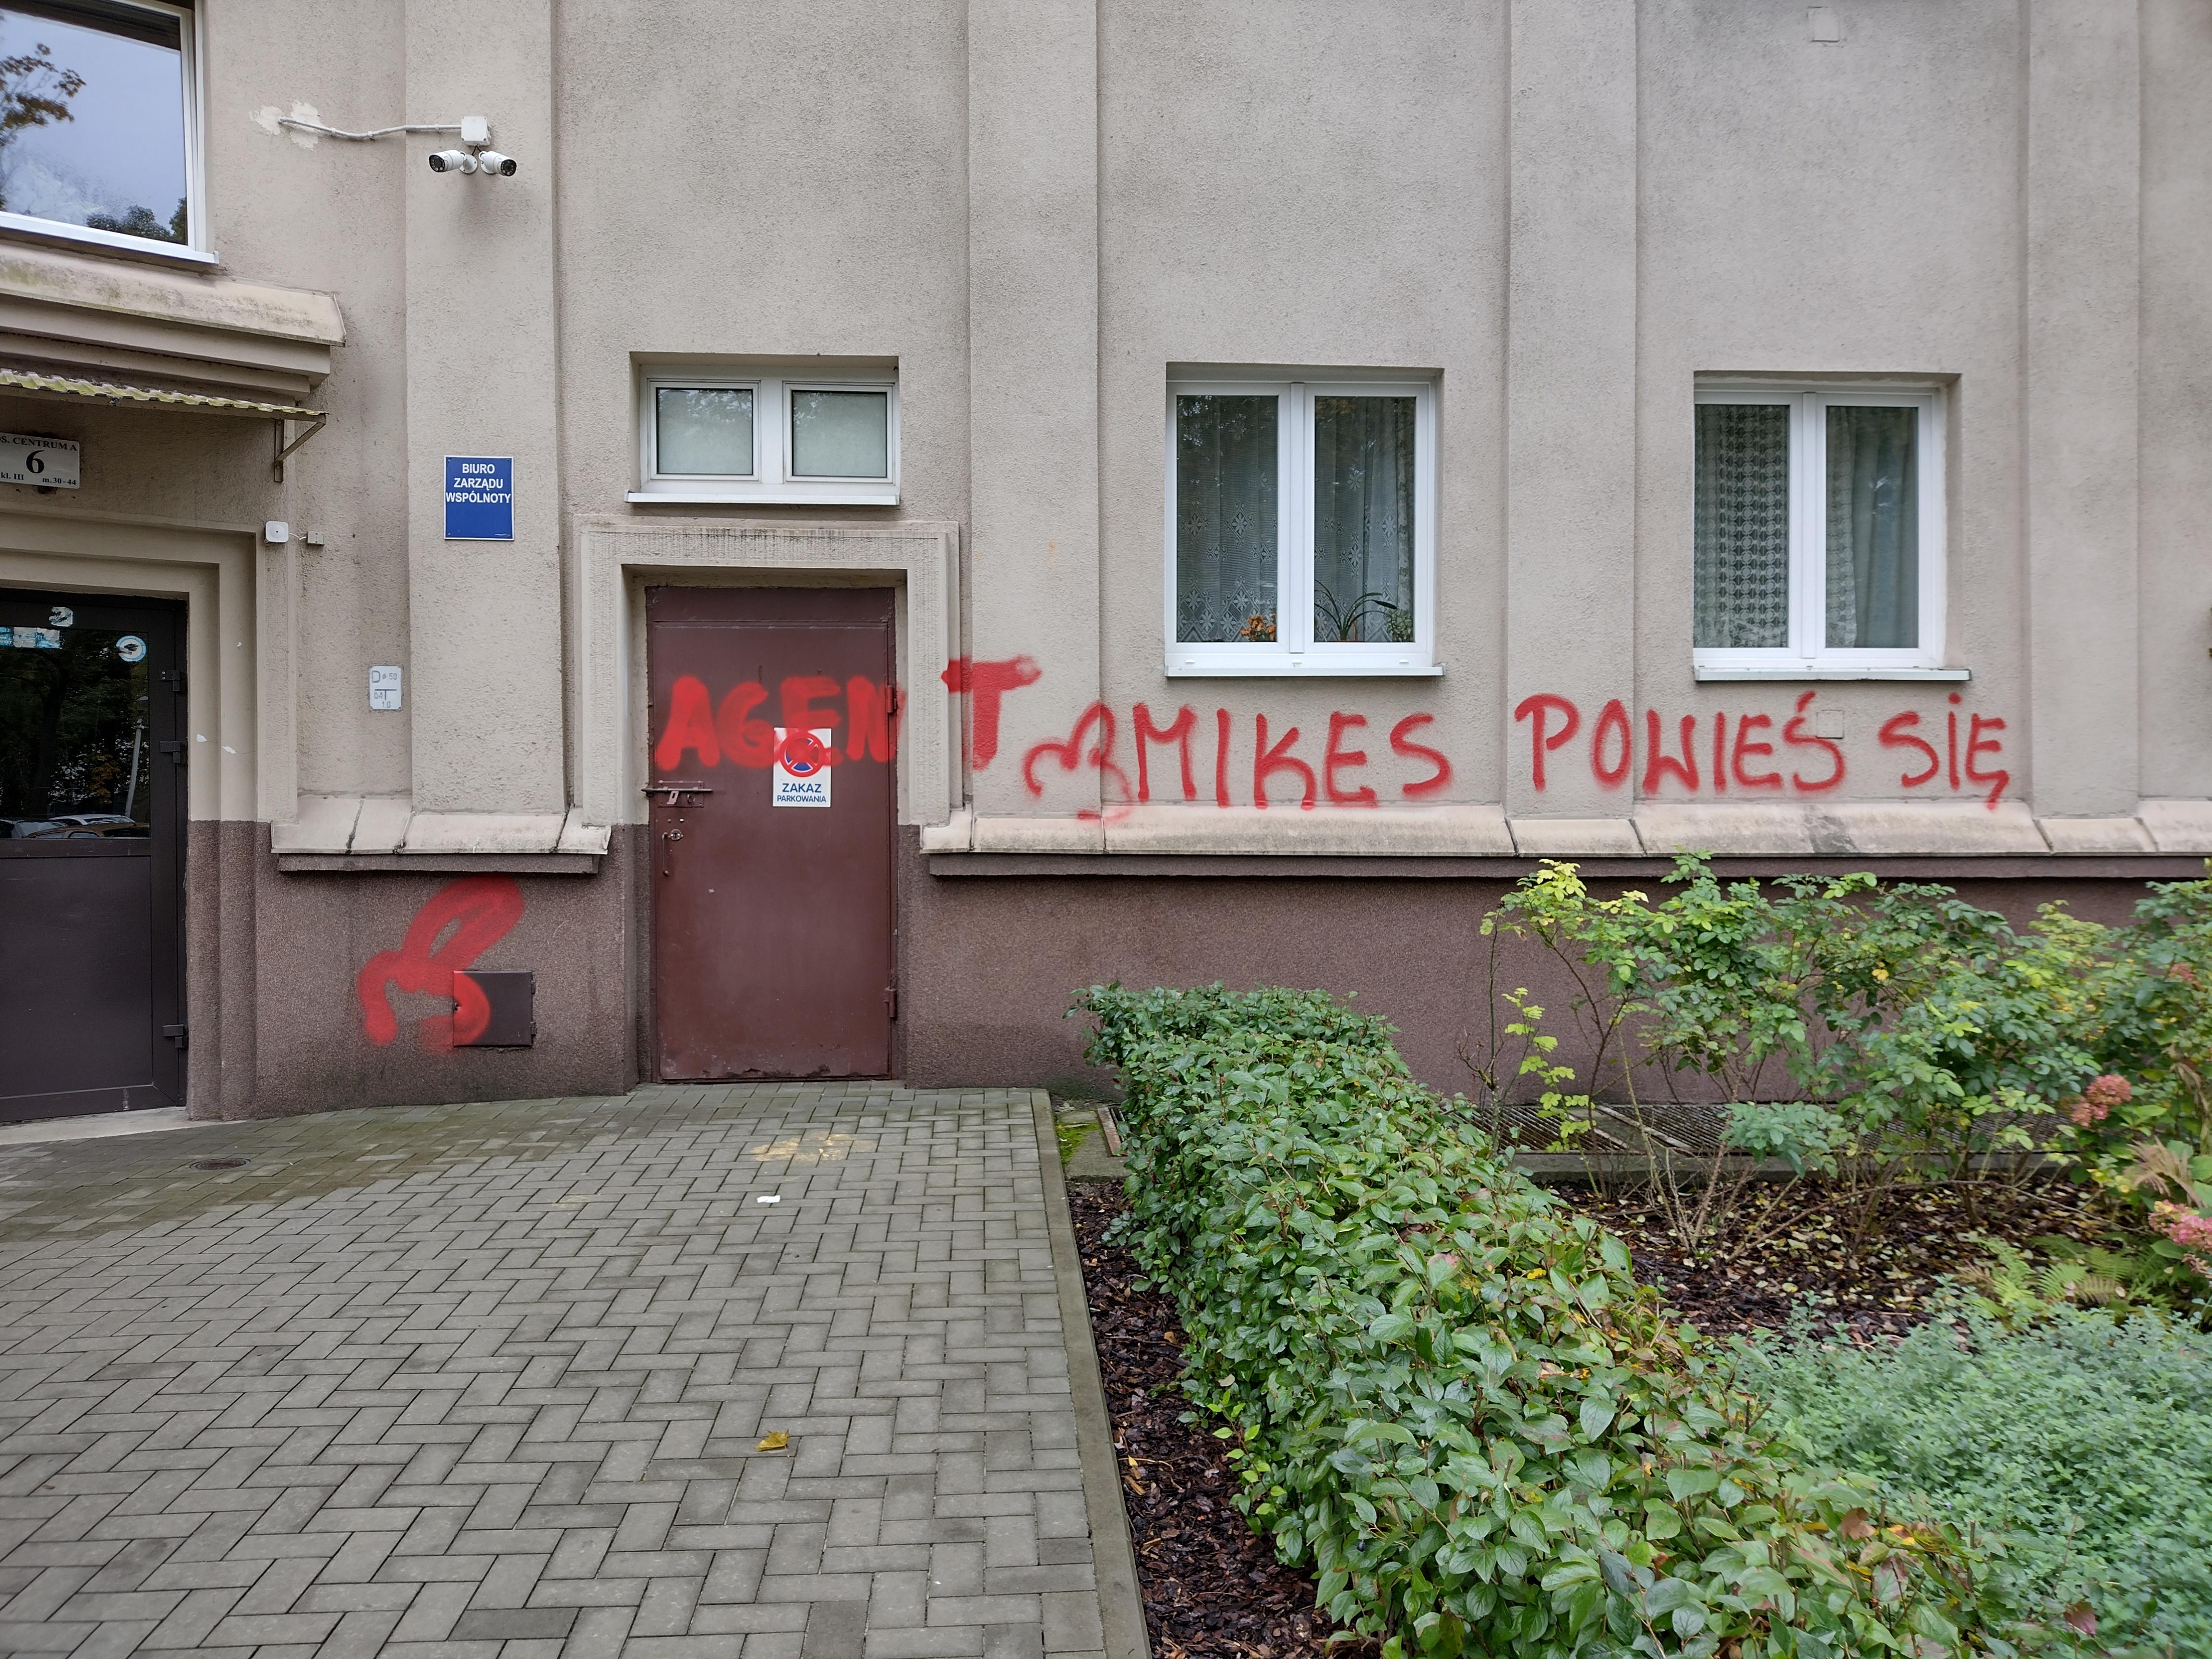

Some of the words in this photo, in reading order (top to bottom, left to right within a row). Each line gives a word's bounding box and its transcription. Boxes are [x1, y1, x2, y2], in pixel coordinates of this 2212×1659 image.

[0, 435, 10, 444] S.
[13, 437, 68, 450] CENTRUM
[26, 450, 45, 474] 6
[462, 463, 495, 474] BIURO
[454, 478, 503, 491] ZARZĄDU
[445, 491, 511, 503] WSPÓLNOTY
[372, 670, 381, 683] D
[656, 655, 1042, 771] AGENT
[1131, 702, 1454, 809] MIKES
[1514, 691, 1846, 794] POWIEŚ
[782, 783, 822, 793] ZAKAZ
